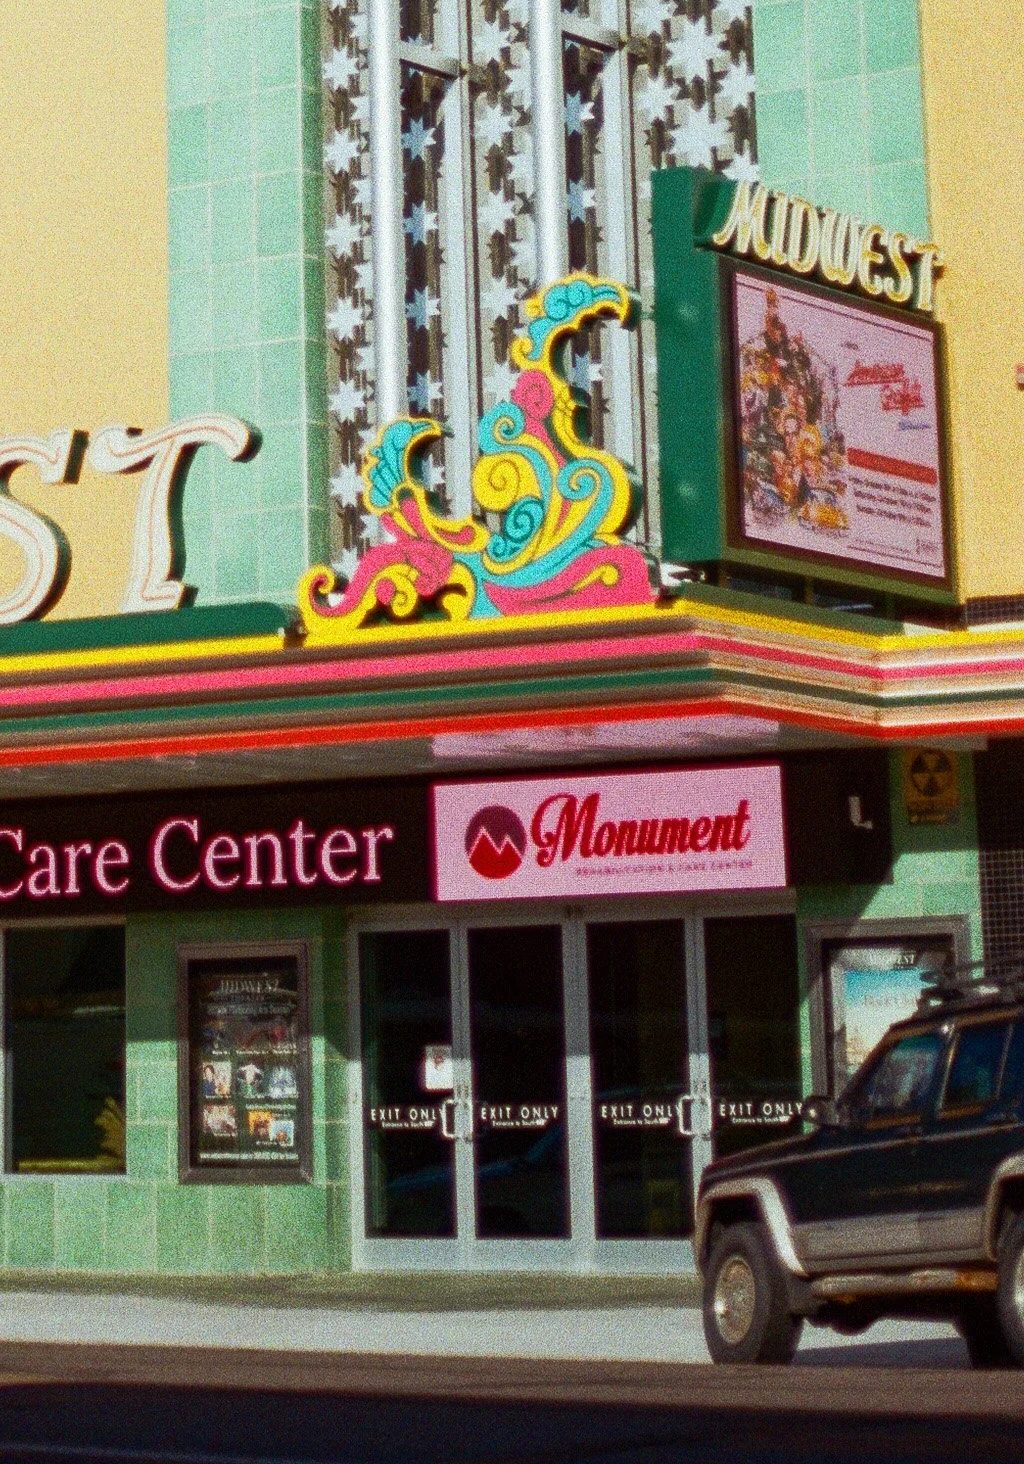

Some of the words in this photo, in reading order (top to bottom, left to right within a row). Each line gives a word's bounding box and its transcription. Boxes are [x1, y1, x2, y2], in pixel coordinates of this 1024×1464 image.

[712, 182, 945, 311] MIDWEST
[530, 792, 750, 868] Monument
[152, 819, 395, 890] Center
[370, 1107, 400, 1121] EXIT
[480, 1106, 511, 1120] EXIT
[520, 1106, 558, 1120] ONLY
[601, 1104, 633, 1119] EXIT
[719, 1102, 752, 1117] EXIT
[762, 1102, 803, 1116] ONLY
